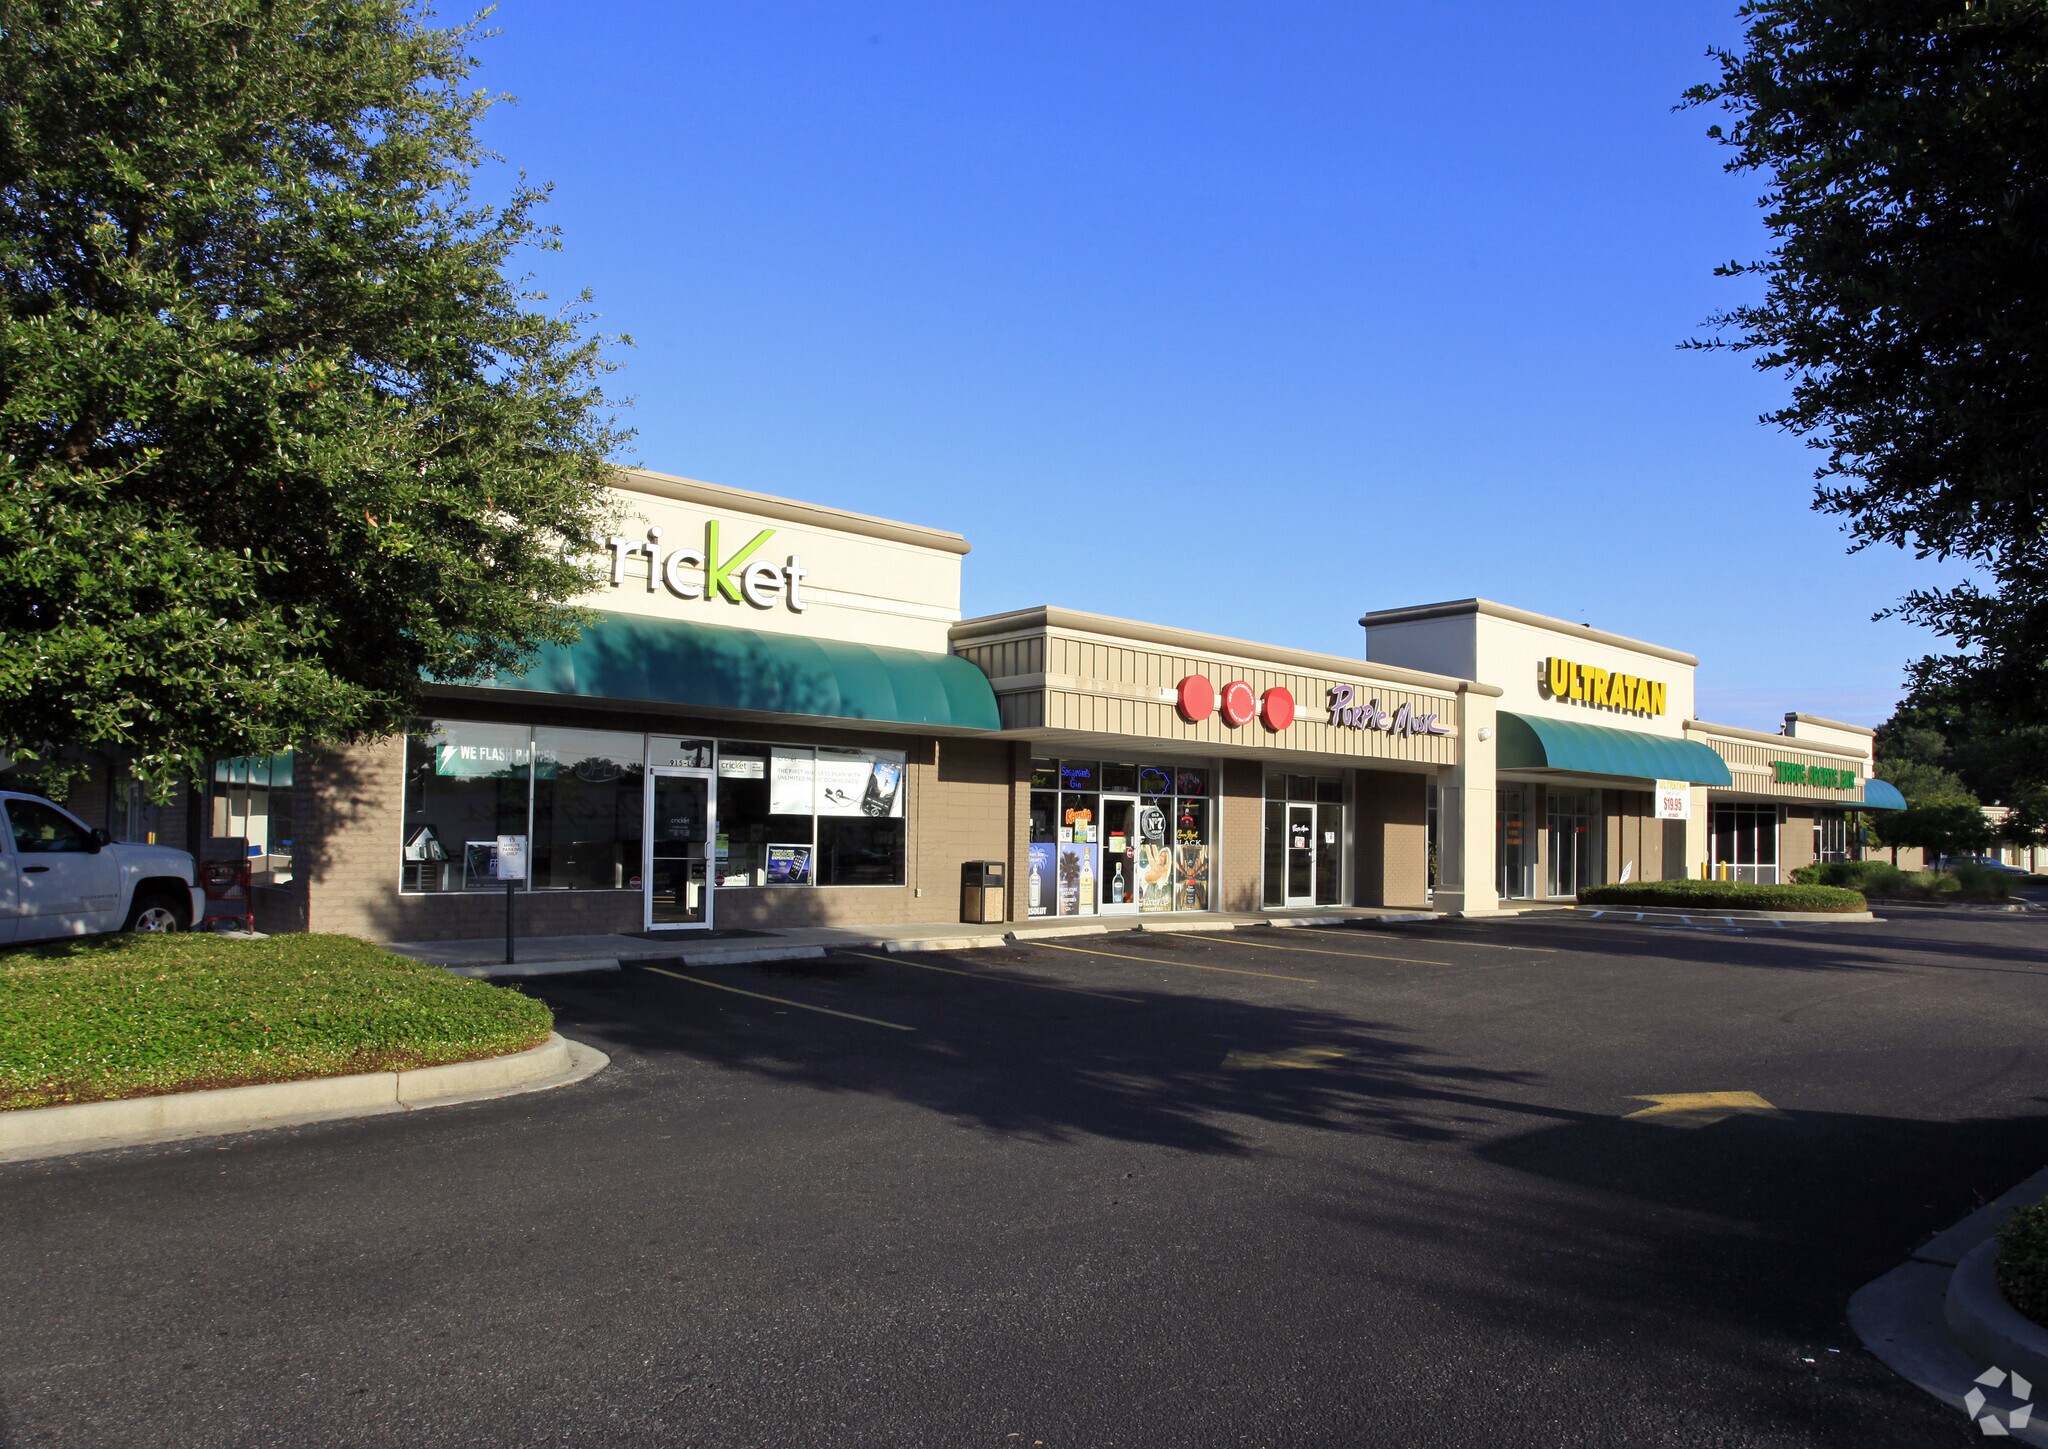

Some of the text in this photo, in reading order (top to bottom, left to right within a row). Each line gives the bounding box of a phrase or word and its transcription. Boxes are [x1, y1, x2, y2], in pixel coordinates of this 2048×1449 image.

[564, 520, 808, 611] ricket
[1548, 656, 1667, 716] ULTRATAN
[1393, 702, 1450, 738] Music
[461, 745, 557, 764] WE FLASH PHNES
[1809, 765, 1839, 788] SPORTS
[1663, 797, 1682, 811] $19.95
